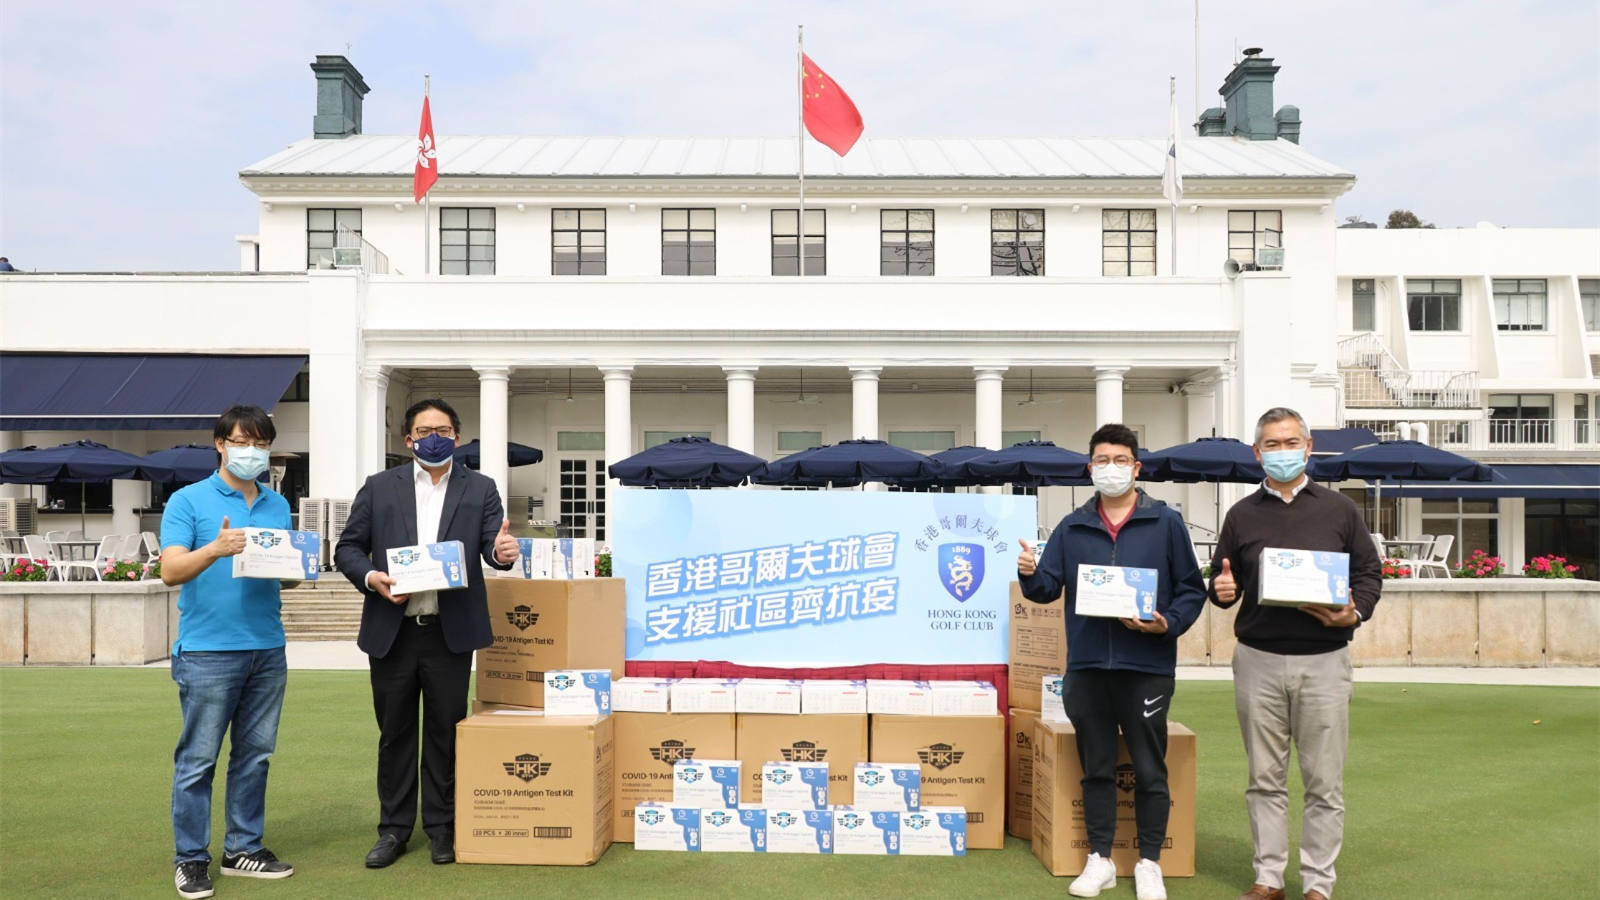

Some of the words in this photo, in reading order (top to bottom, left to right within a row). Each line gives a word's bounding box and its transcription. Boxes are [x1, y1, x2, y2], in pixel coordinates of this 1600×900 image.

[914, 514, 1008, 554] 香港哥爾夫球會
[952, 546, 971, 555] 1889
[647, 532, 898, 598] 香港哥爾夫球會
[646, 577, 898, 642] 支援社區齊抗疫
[928, 609, 961, 619] HONG
[965, 609, 997, 619] KONG
[514, 613, 531, 623] HK
[930, 621, 961, 631] GOLF
[964, 621, 994, 631] CLUB
[534, 637, 546, 645] Test
[661, 748, 682, 759] HK
[793, 749, 814, 761] HK
[929, 752, 951, 763] HK
[516, 763, 538, 774] HK
[621, 772, 659, 780] COVID-19
[659, 772, 674, 780] Anti
[837, 774, 848, 782] Kit
[927, 776, 957, 785] Antigen
[473, 788, 512, 797] COVID-19
[513, 788, 544, 798] Antigen
[546, 789, 561, 797] Test
[562, 789, 573, 797] Kit
